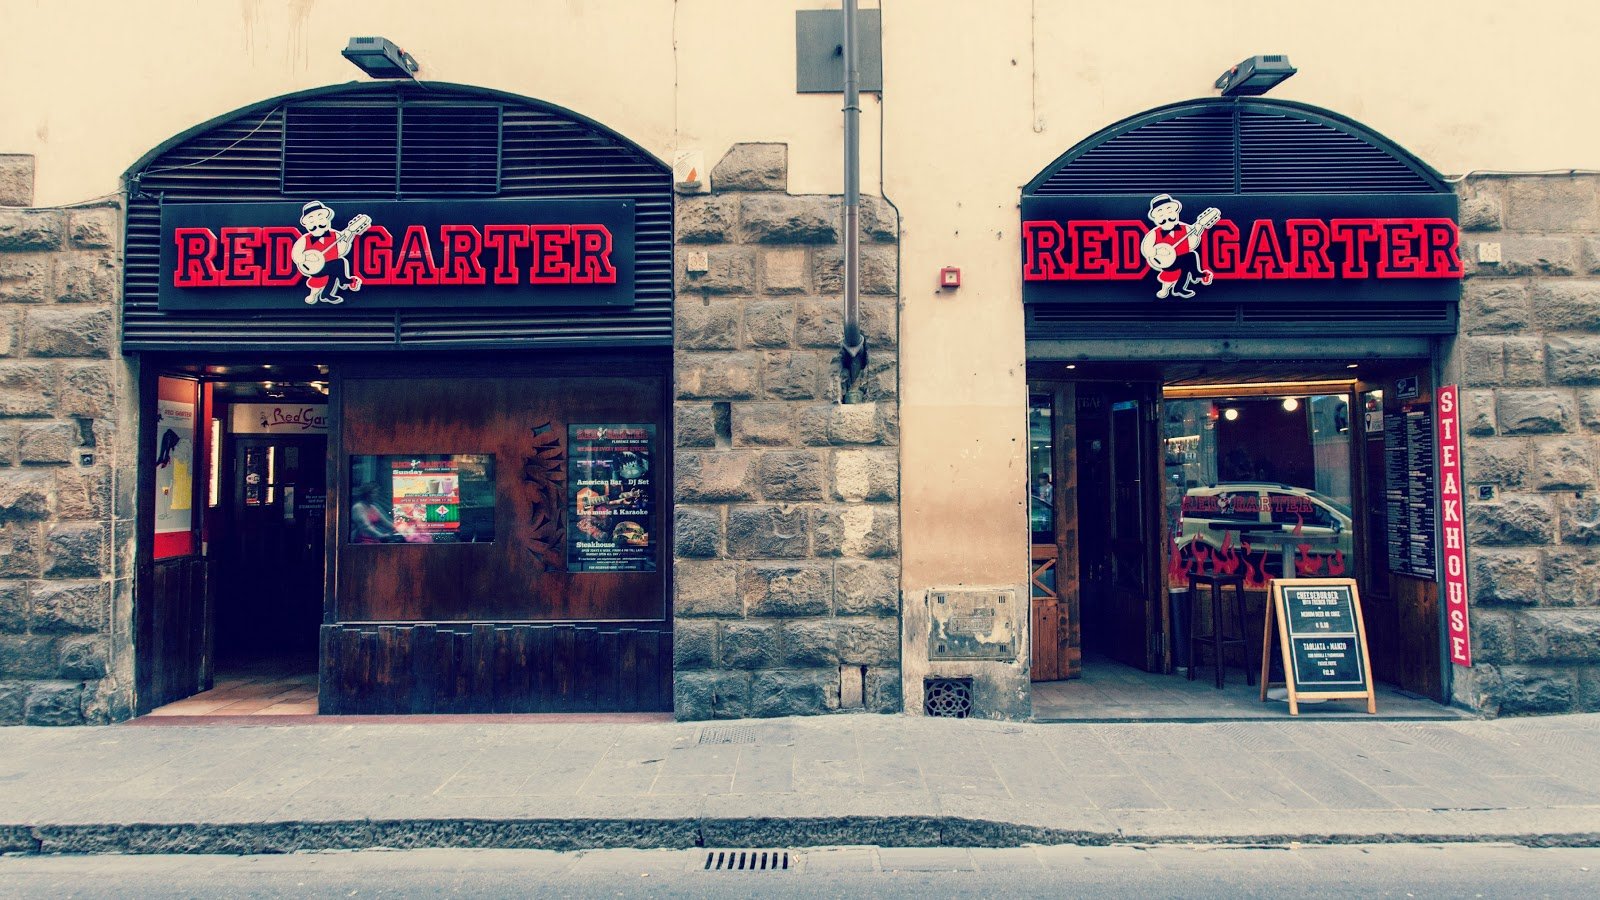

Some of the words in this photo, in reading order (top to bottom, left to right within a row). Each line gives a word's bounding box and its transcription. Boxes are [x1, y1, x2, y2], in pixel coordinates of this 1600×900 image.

[174, 226, 302, 287] RED
[352, 225, 617, 286] GARTER
[1023, 219, 1149, 281] RED
[1201, 218, 1465, 279] GARTER
[1182, 496, 1218, 511] RED
[1234, 496, 1314, 512] GARTER
[1440, 391, 1466, 660] STEAKHOUSE
[1296, 591, 1339, 600] CHEESEBURGER
[1329, 642, 1347, 650] MANZO
